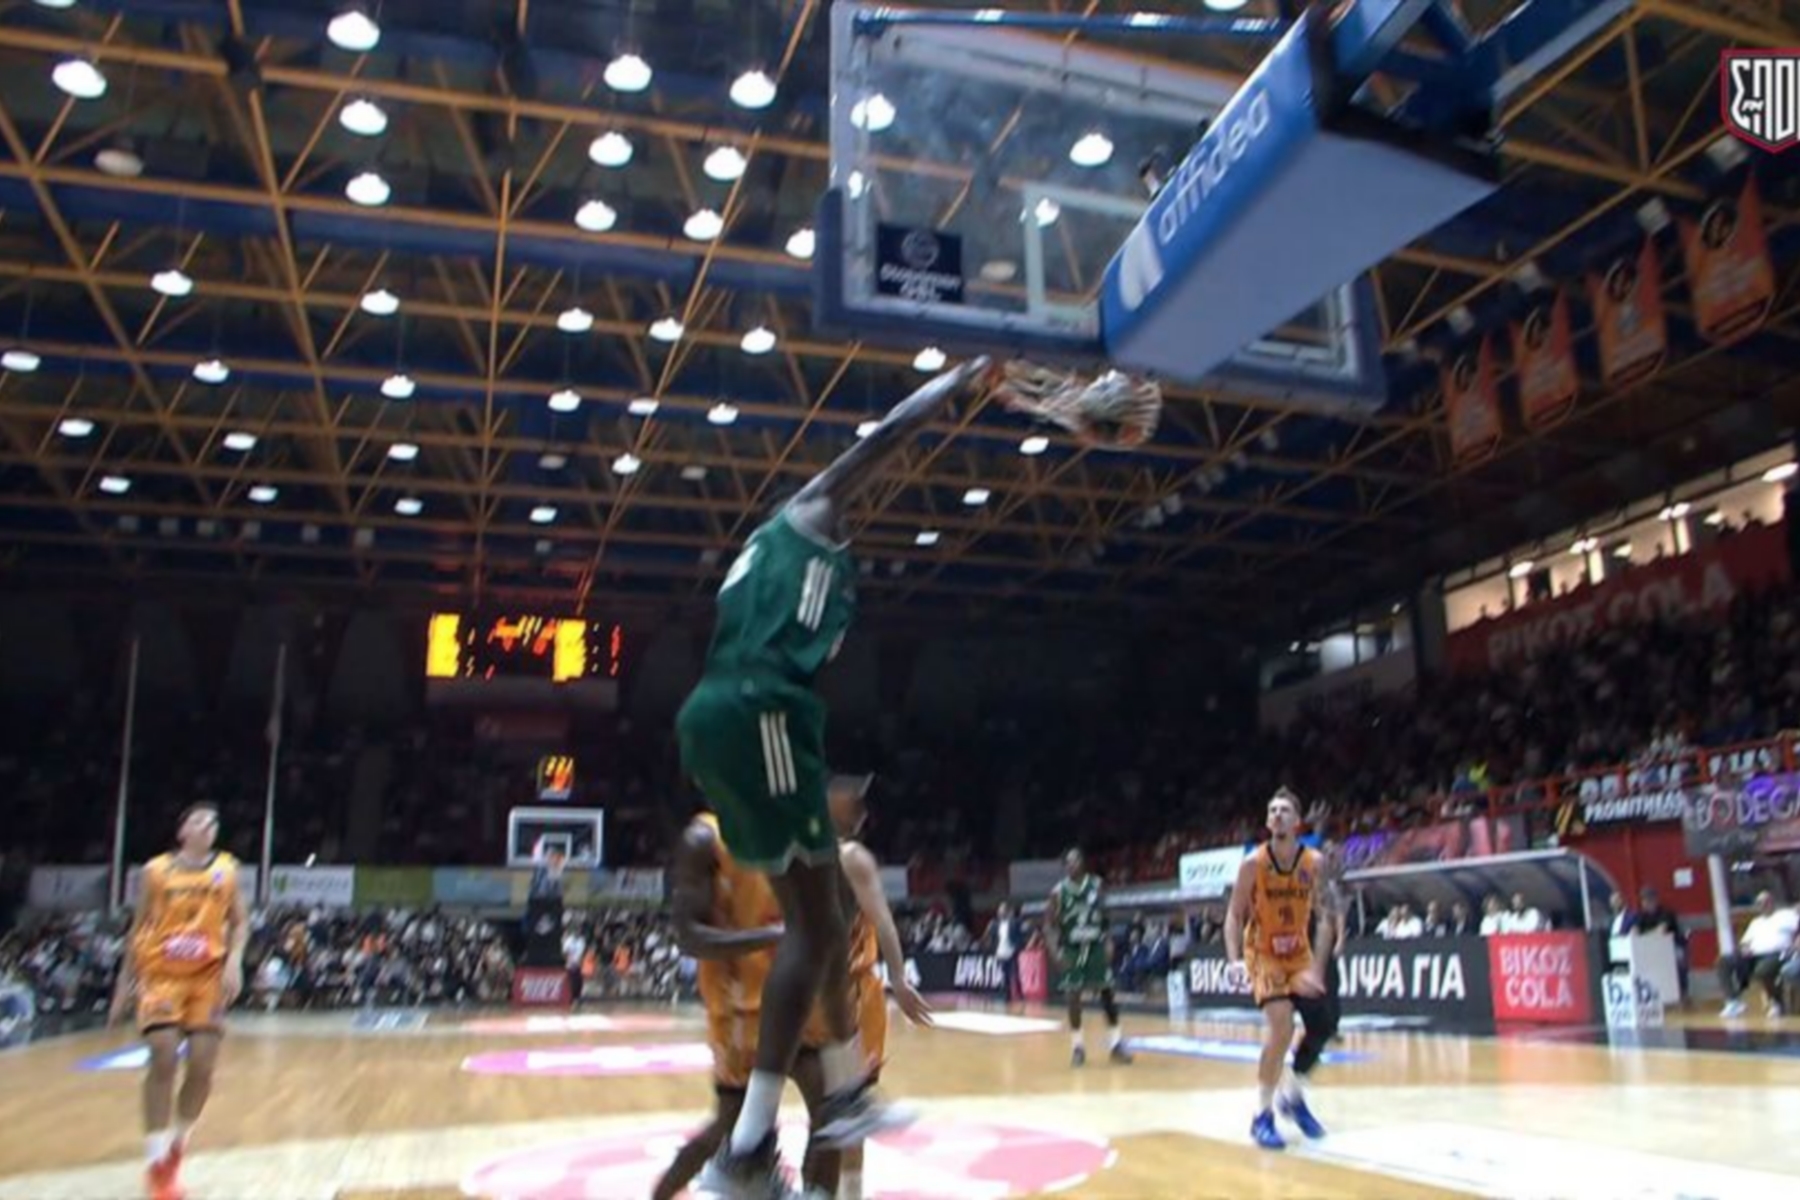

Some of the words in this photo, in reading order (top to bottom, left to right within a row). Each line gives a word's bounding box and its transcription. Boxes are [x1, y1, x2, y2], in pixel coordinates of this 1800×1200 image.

[1158, 86, 1270, 246] affidea
[1696, 785, 1800, 830] BODEG
[1411, 953, 1466, 999] ΓΙΑ
[1506, 976, 1573, 1009] COLA
